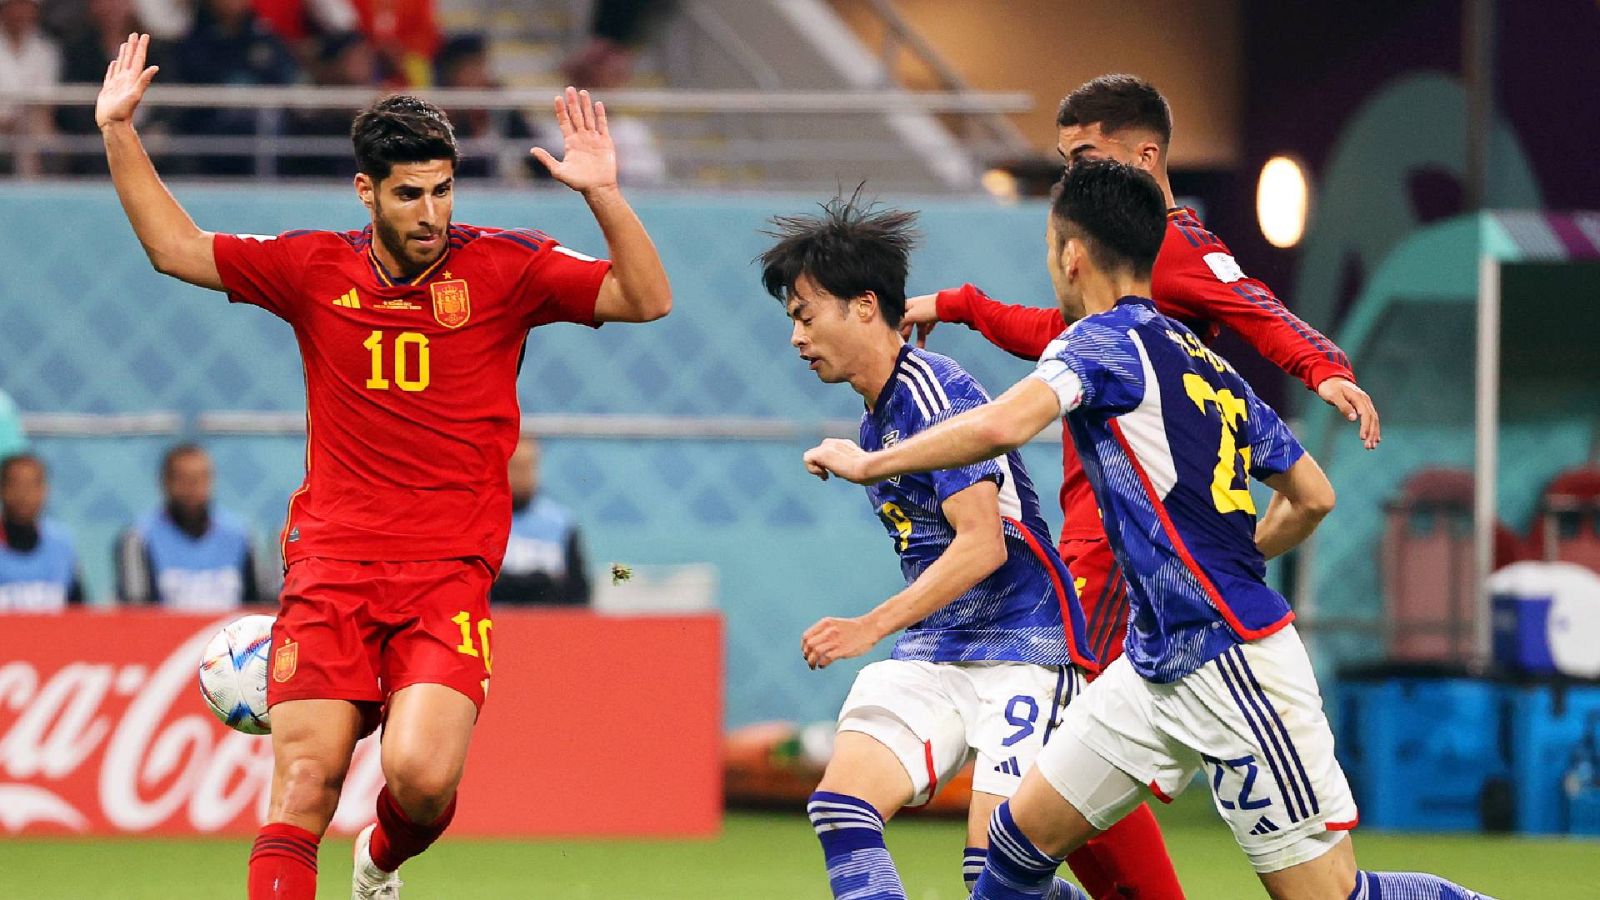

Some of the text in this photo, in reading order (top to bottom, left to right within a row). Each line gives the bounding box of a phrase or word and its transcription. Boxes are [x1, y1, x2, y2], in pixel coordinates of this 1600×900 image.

[363, 330, 430, 392] 10
[882, 501, 912, 551] 9
[1001, 695, 1039, 747] 9
[1200, 752, 1272, 810] 22
